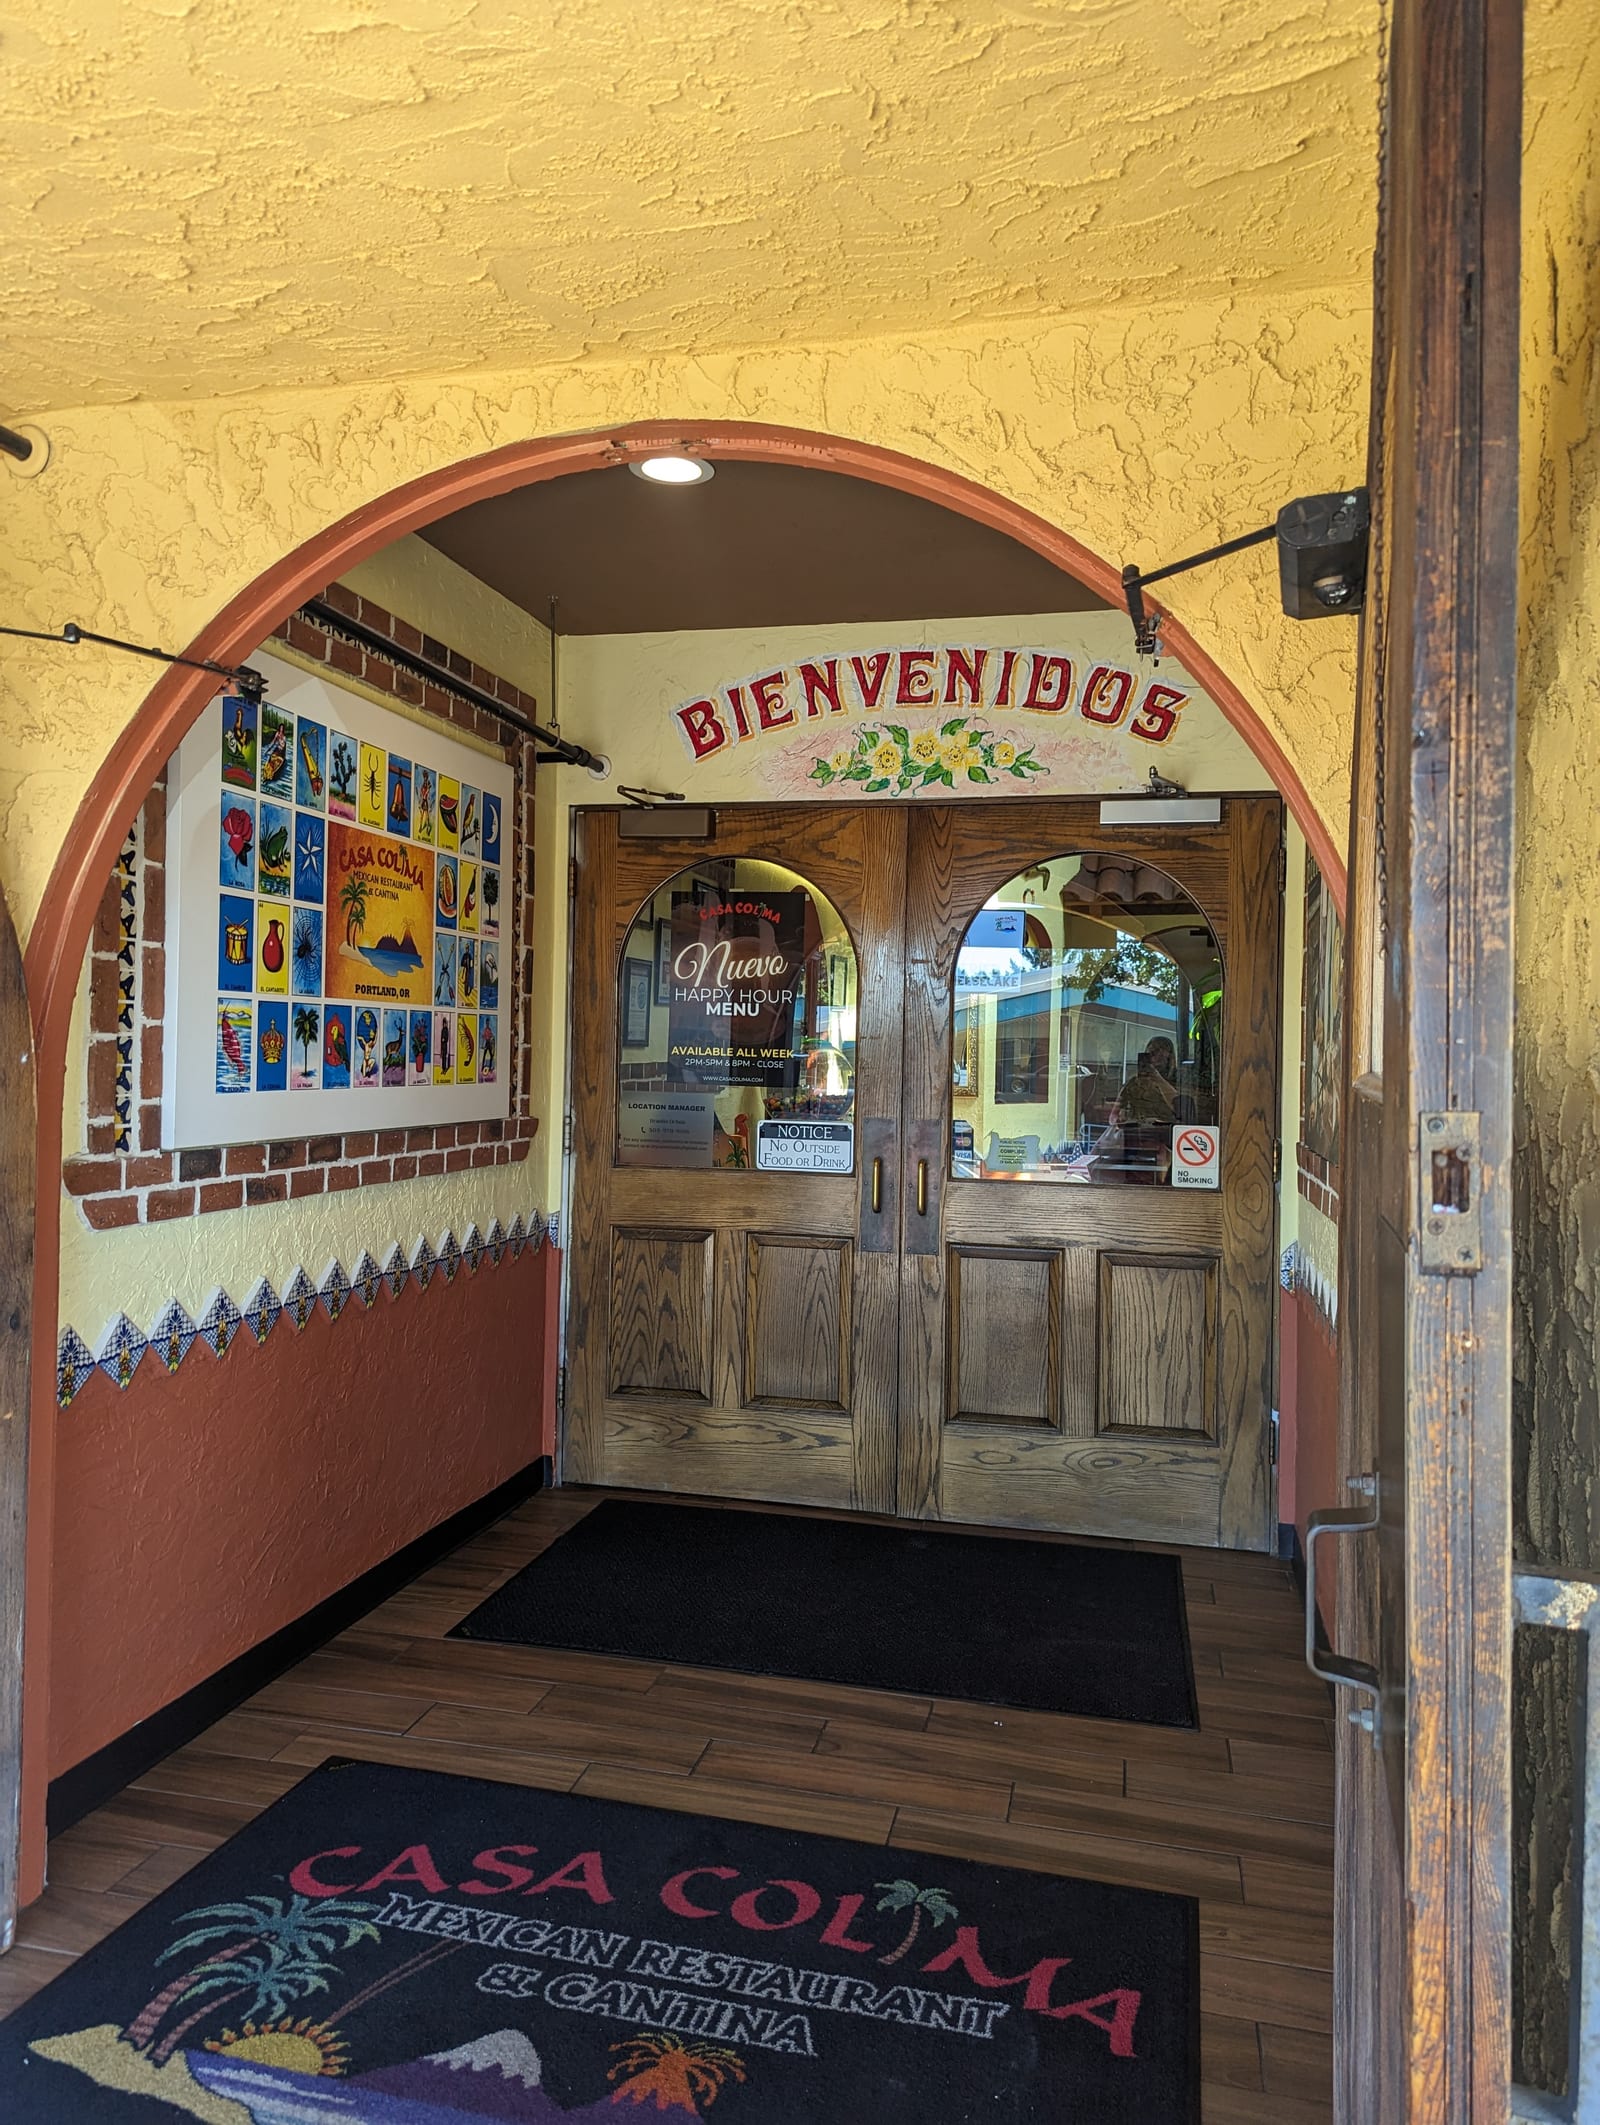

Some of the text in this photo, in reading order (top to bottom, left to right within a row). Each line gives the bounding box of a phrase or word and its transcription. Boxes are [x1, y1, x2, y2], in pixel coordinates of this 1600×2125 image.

[676, 648, 1189, 763] BIENVENIDOS
[340, 846, 375, 873] CASA
[353, 870, 414, 892] MEXICAN RESTAURANT
[368, 888, 400, 902] & CANTINA
[699, 903, 733, 920] CASA
[674, 940, 789, 988] Nuevo
[400, 988, 411, 998] OR
[675, 988, 793, 1004] HAPPY HOUR
[706, 1002, 760, 1017] MENU
[671, 1046, 795, 1059] AVAILABLE ALL WEEK
[685, 1058, 723, 1067] 2PM-5PM
[724, 1059, 730, 1067] &
[731, 1059, 751, 1067] 8PM
[757, 1060, 785, 1069] CLOSE
[628, 1103, 706, 1112] LOCATION MANAGER
[777, 1125, 833, 1139] NOTICE
[793, 1140, 841, 1154] OUTSIDE
[764, 1153, 846, 1168] FOOD OR DRINK
[1177, 1177, 1213, 1185] SMOKING
[289, 1843, 616, 1905] CASA
[370, 1892, 1010, 2039] MEXICAN RESTAURANT
[475, 1963, 820, 2057] & CANTINA
